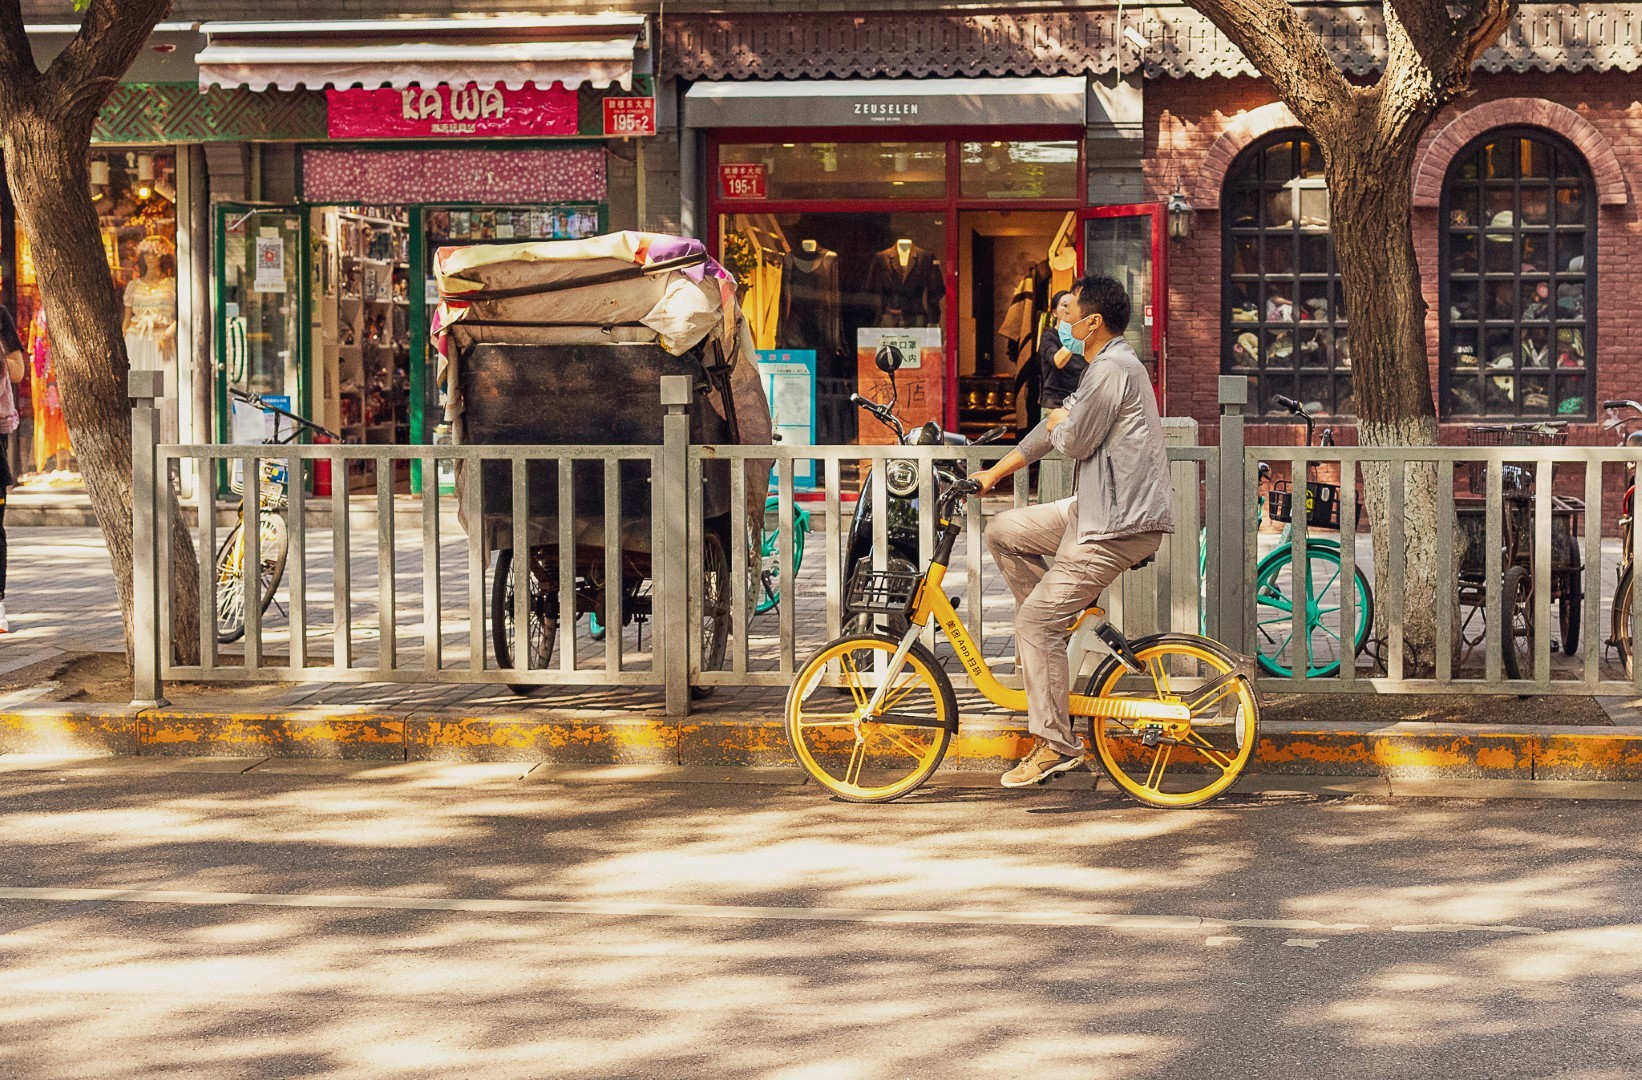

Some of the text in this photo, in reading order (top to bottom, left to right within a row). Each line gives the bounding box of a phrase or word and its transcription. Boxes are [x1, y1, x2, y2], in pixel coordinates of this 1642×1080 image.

[401, 87, 504, 120] KA WA
[854, 103, 918, 114] ZEUSELEN
[612, 113, 650, 131] 195-2
[728, 179, 757, 194] 195-1
[946, 620, 982, 676] 美团 App 扫码
